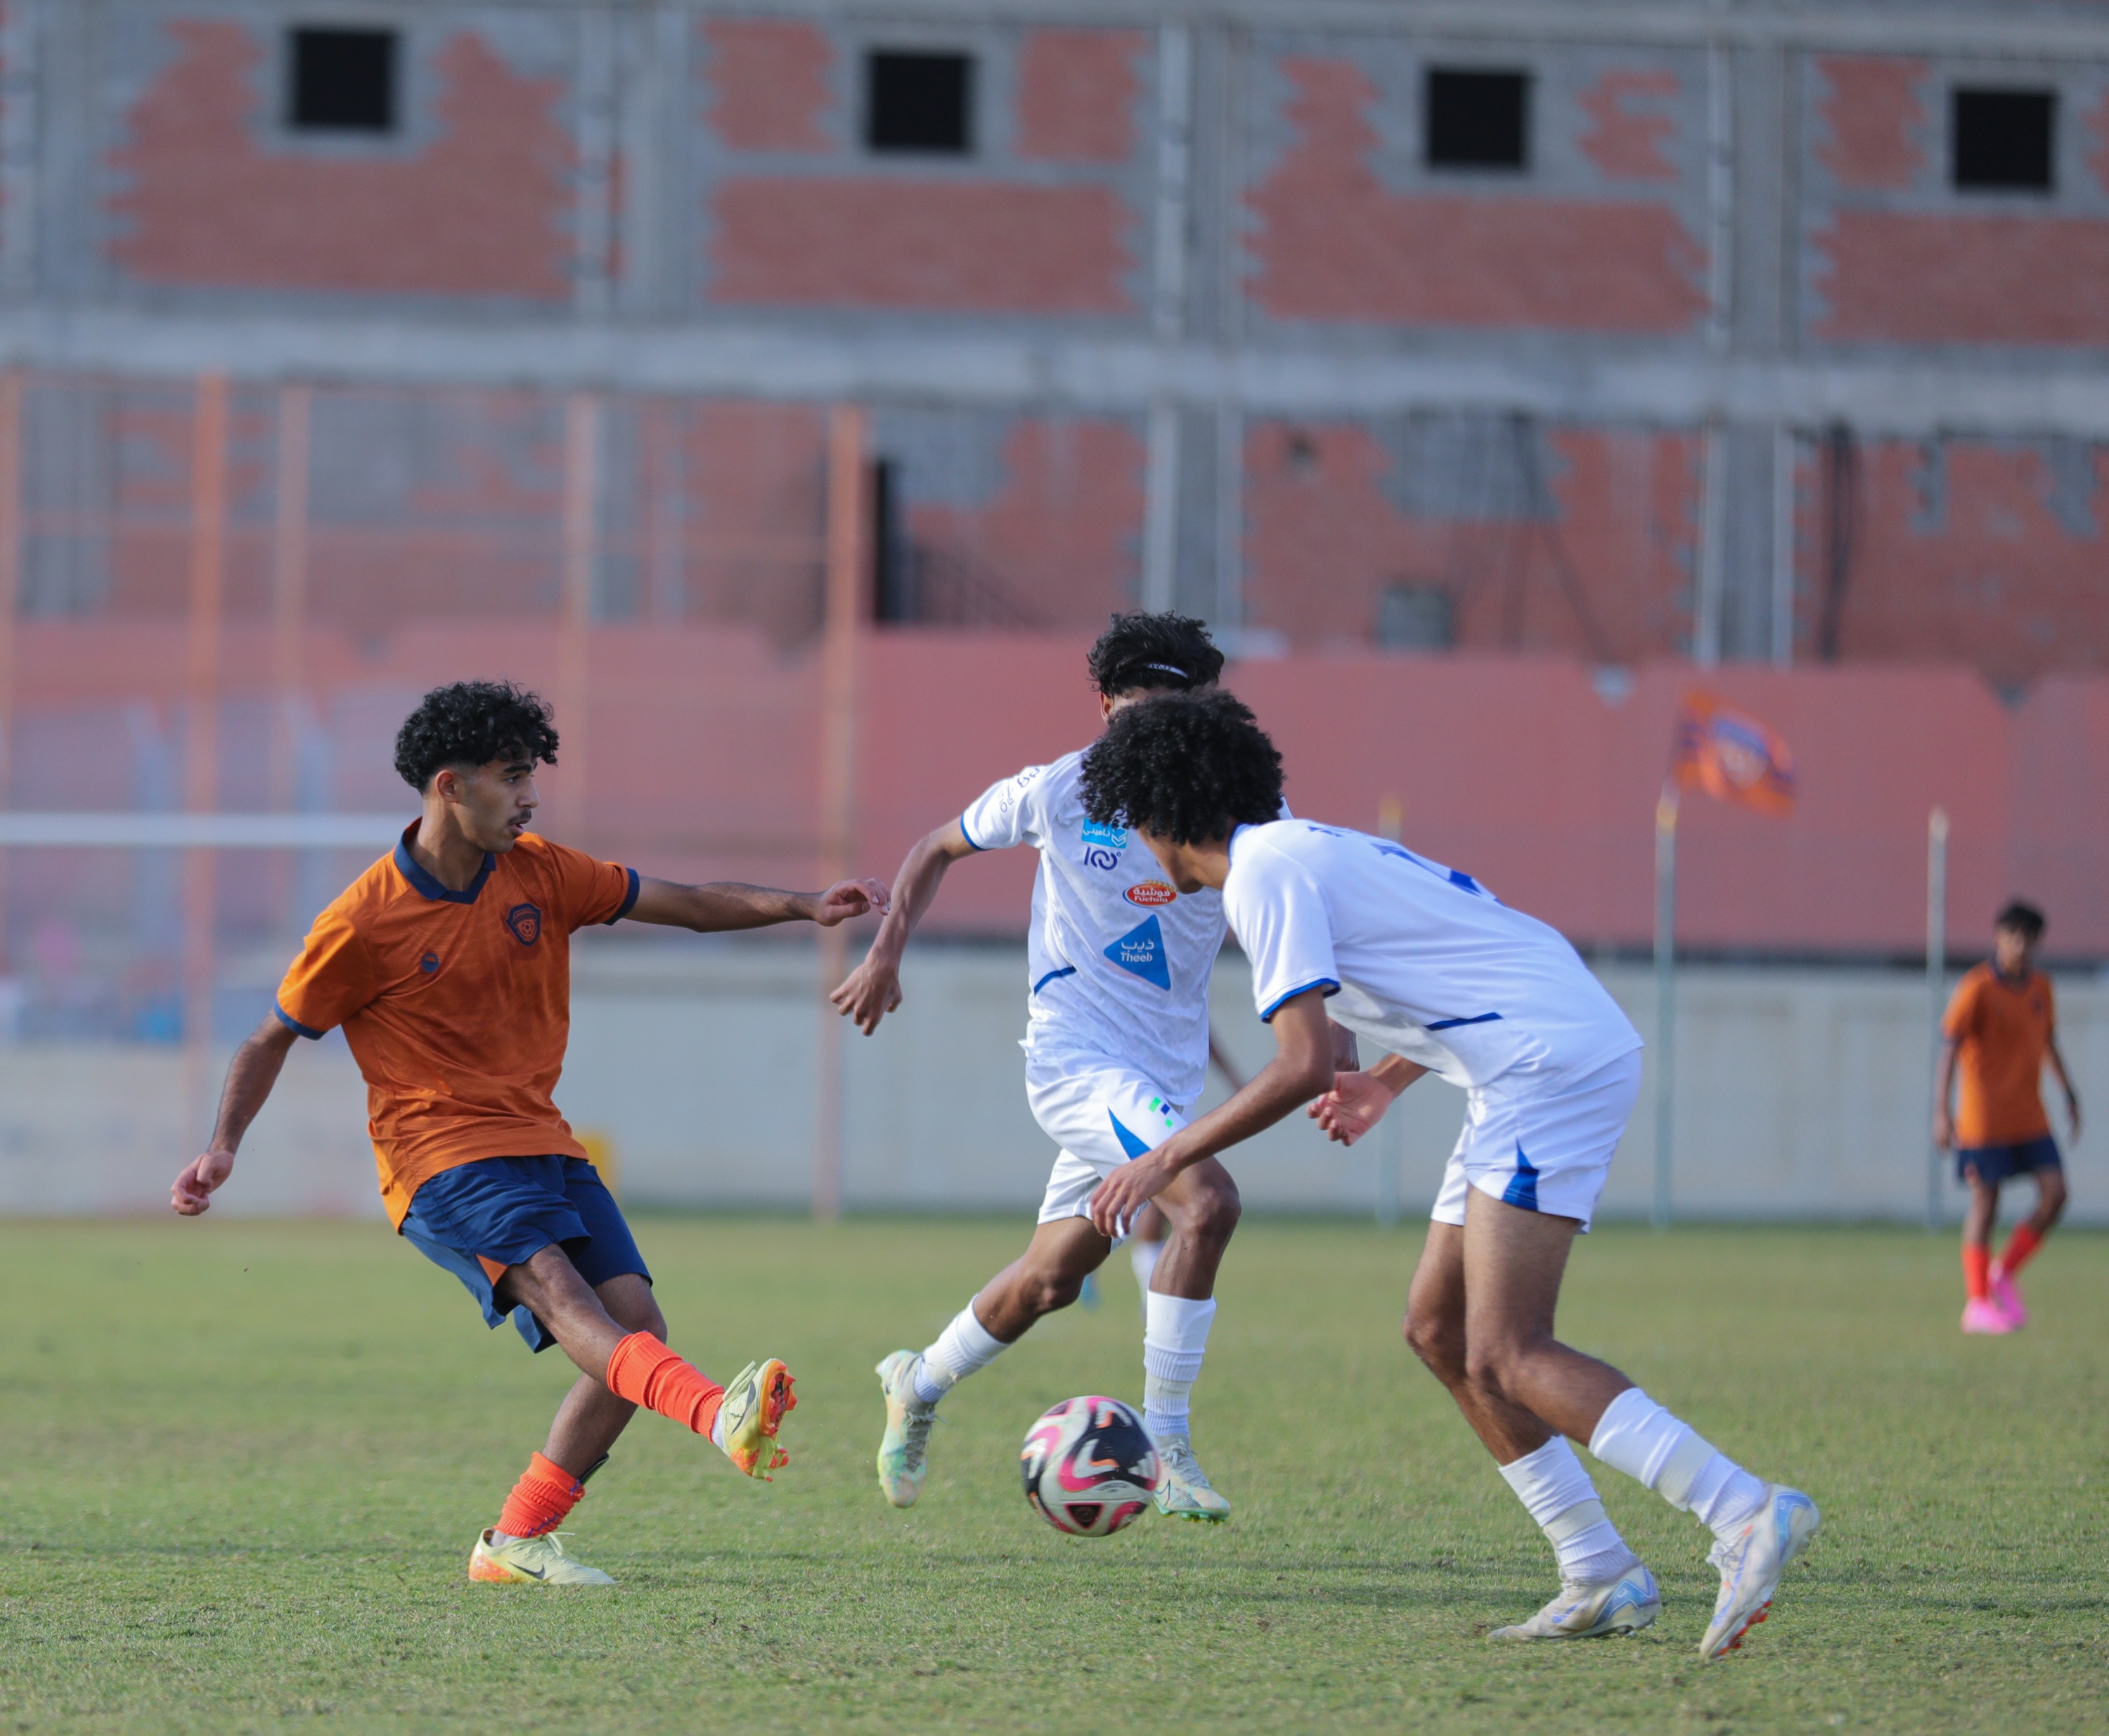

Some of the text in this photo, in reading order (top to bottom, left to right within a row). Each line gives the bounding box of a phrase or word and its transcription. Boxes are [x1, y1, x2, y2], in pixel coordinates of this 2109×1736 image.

[1134, 895, 1168, 904] Fuchsia
[1121, 937, 1154, 953] ذيب
[1120, 951, 1153, 963] Theeb
